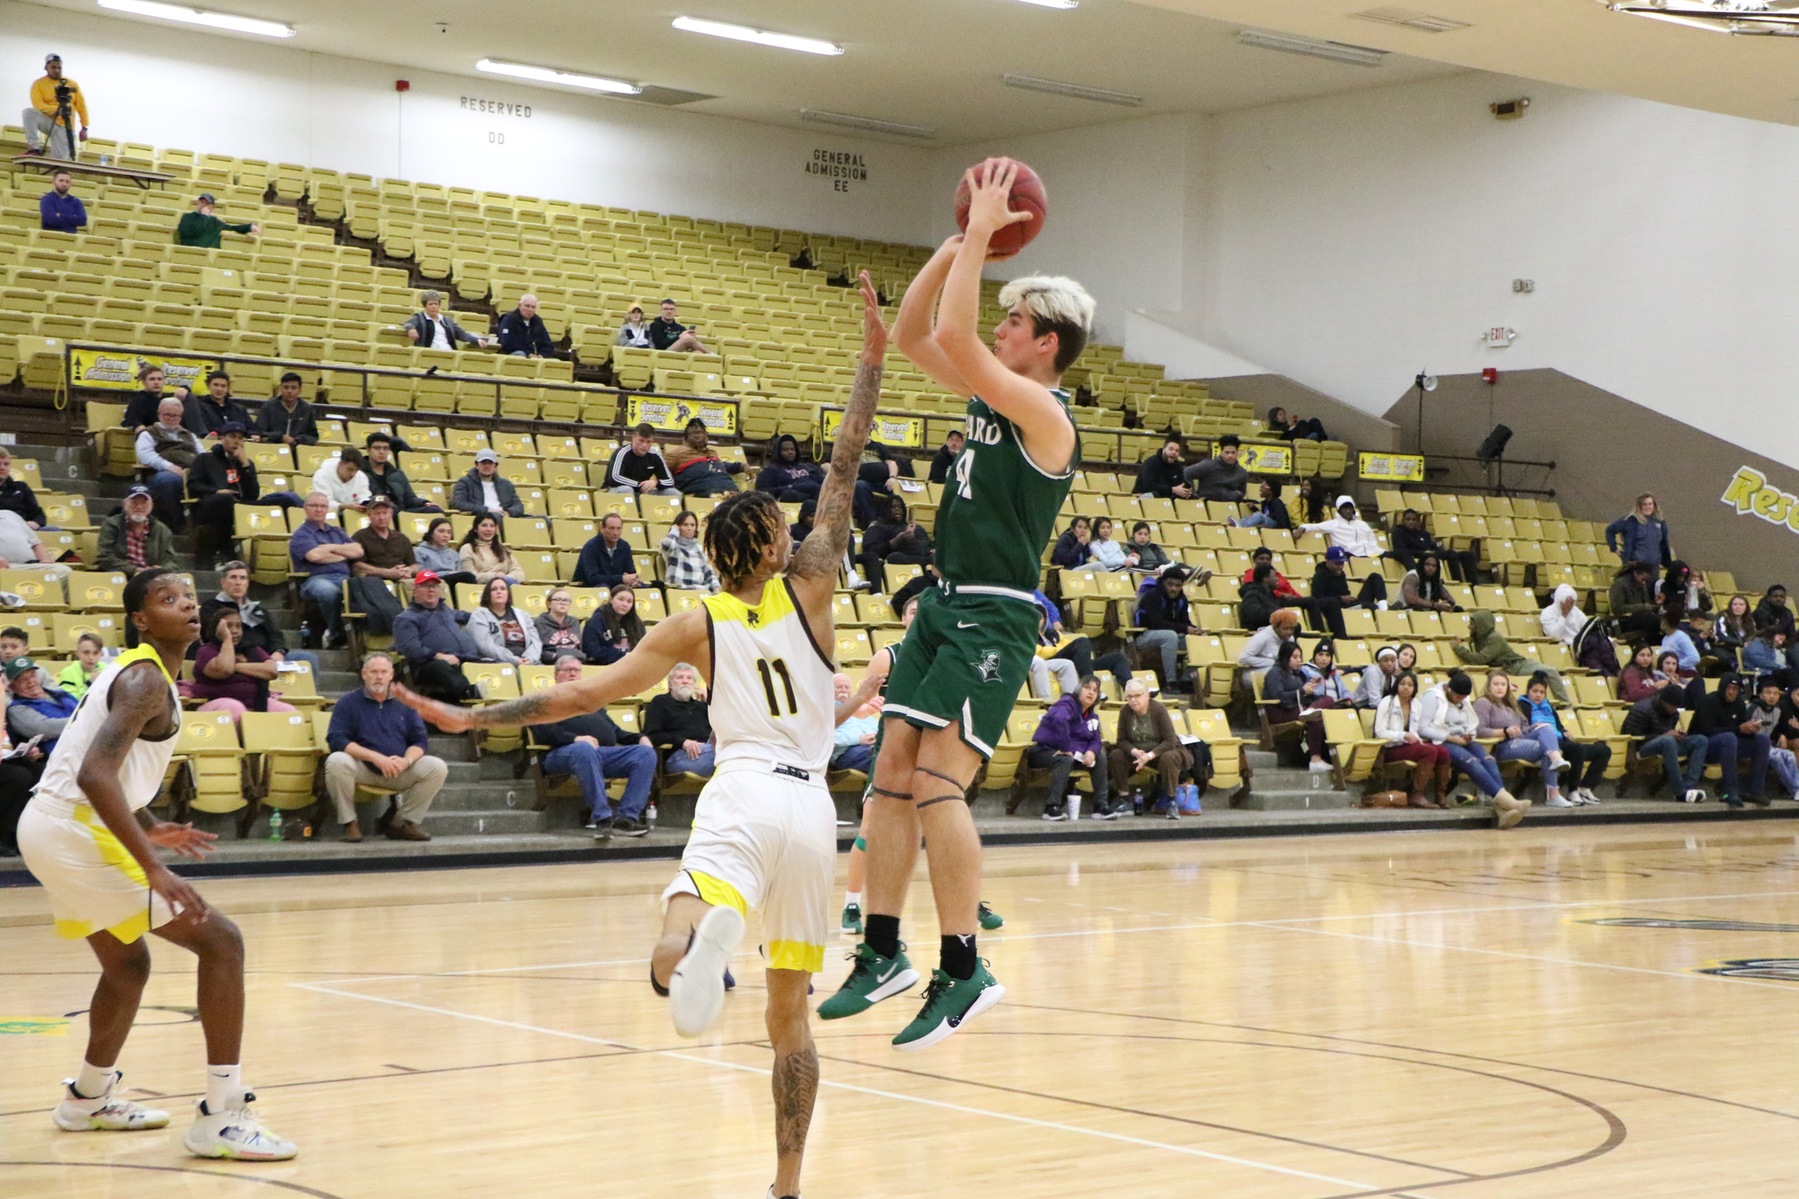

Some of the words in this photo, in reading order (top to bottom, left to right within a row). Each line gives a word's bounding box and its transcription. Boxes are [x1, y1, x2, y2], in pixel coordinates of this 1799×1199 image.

[460, 96, 532, 118] RESERVED
[488, 131, 505, 145] DD
[813, 149, 865, 167] GENERAL
[805, 161, 867, 181] ADMISSION
[834, 179, 849, 192] EE
[1490, 327, 1504, 340] EXIT
[95, 356, 131, 370] General
[161, 362, 201, 377] Reserved
[83, 367, 132, 383] Admission
[641, 401, 673, 414] Reserved
[699, 405, 725, 417] General
[640, 413, 667, 426] Seating
[881, 420, 909, 433] Reserved
[883, 431, 905, 443] Seating
[757, 658, 798, 718] 11
